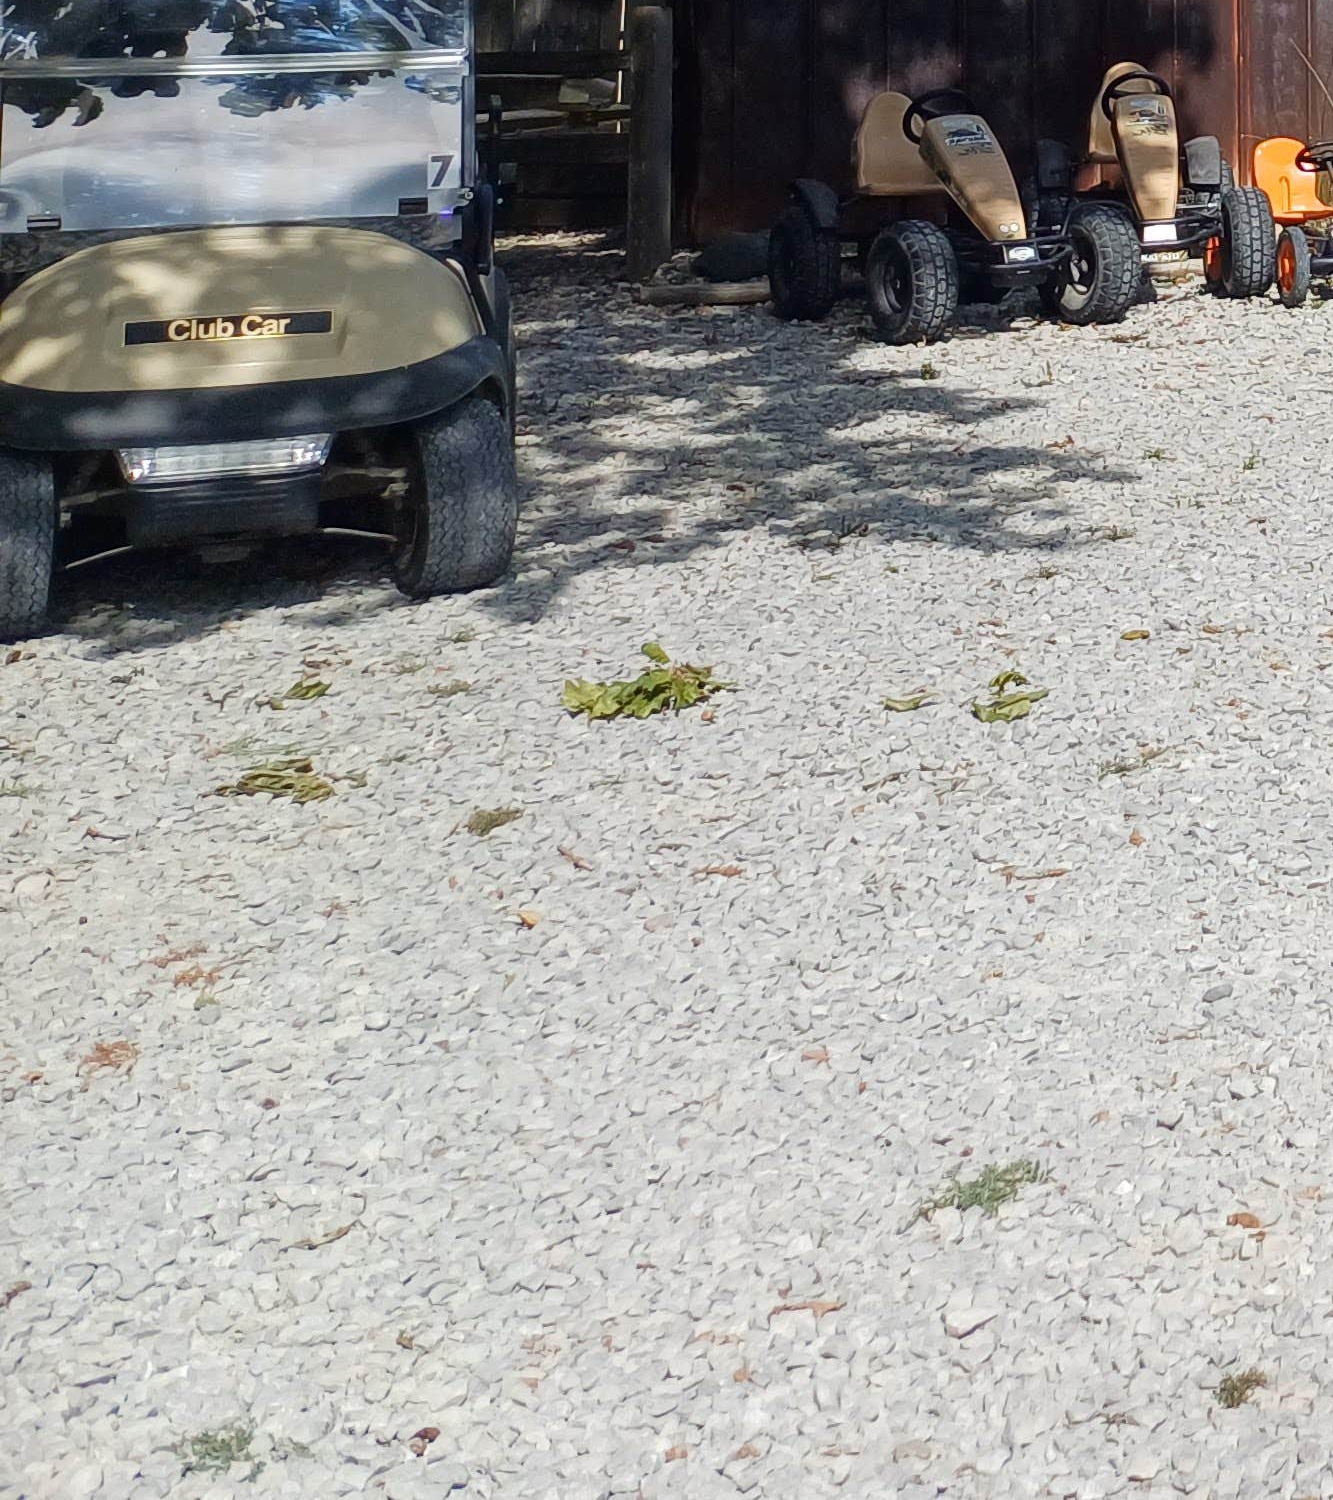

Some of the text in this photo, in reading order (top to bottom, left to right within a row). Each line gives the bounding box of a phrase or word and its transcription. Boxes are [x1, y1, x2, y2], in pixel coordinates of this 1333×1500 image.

[430, 155, 455, 188] 7
[168, 315, 291, 341] Club Car
